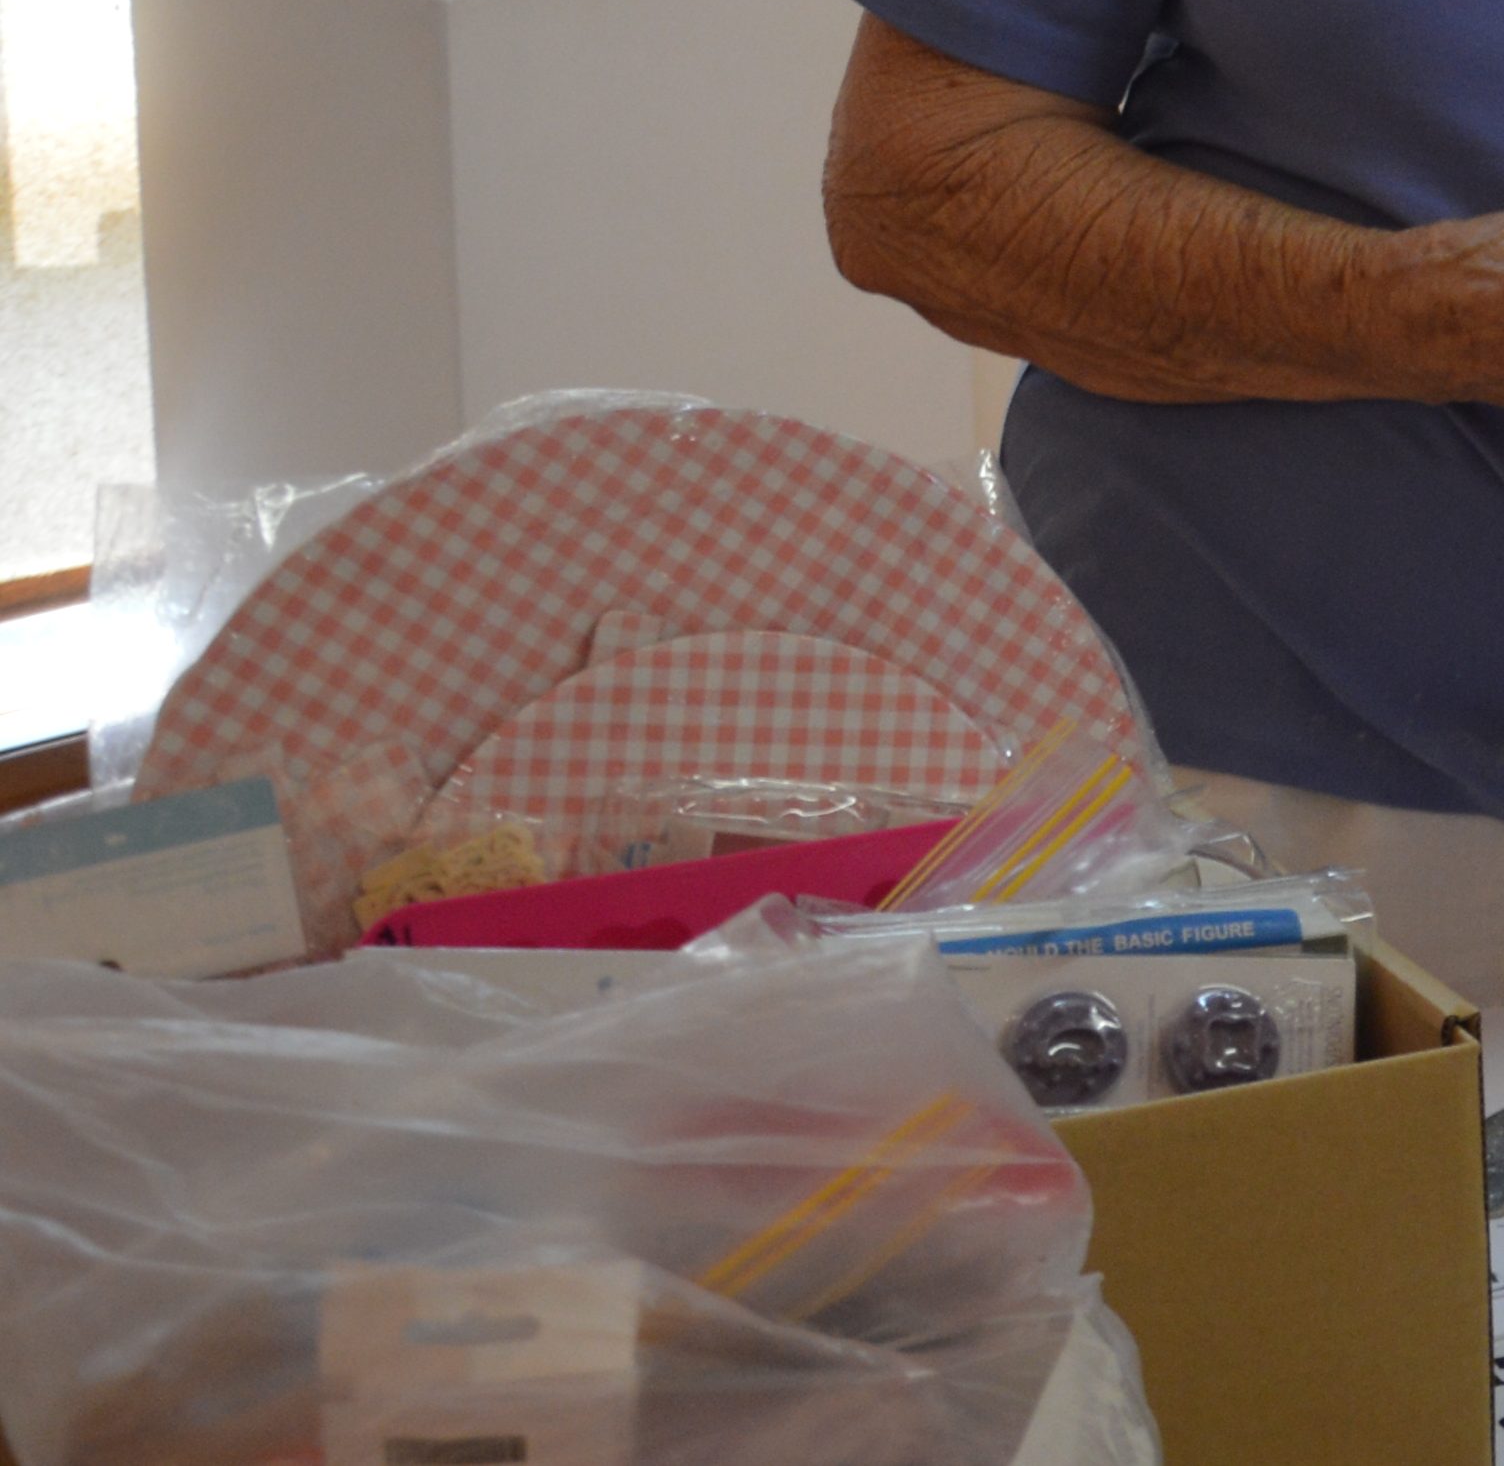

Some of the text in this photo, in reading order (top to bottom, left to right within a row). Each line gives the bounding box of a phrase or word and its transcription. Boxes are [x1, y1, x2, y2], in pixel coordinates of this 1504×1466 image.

[1066, 938, 1104, 955] THE
[1114, 930, 1174, 952] BASIC
[1182, 921, 1256, 944] FIGURE
